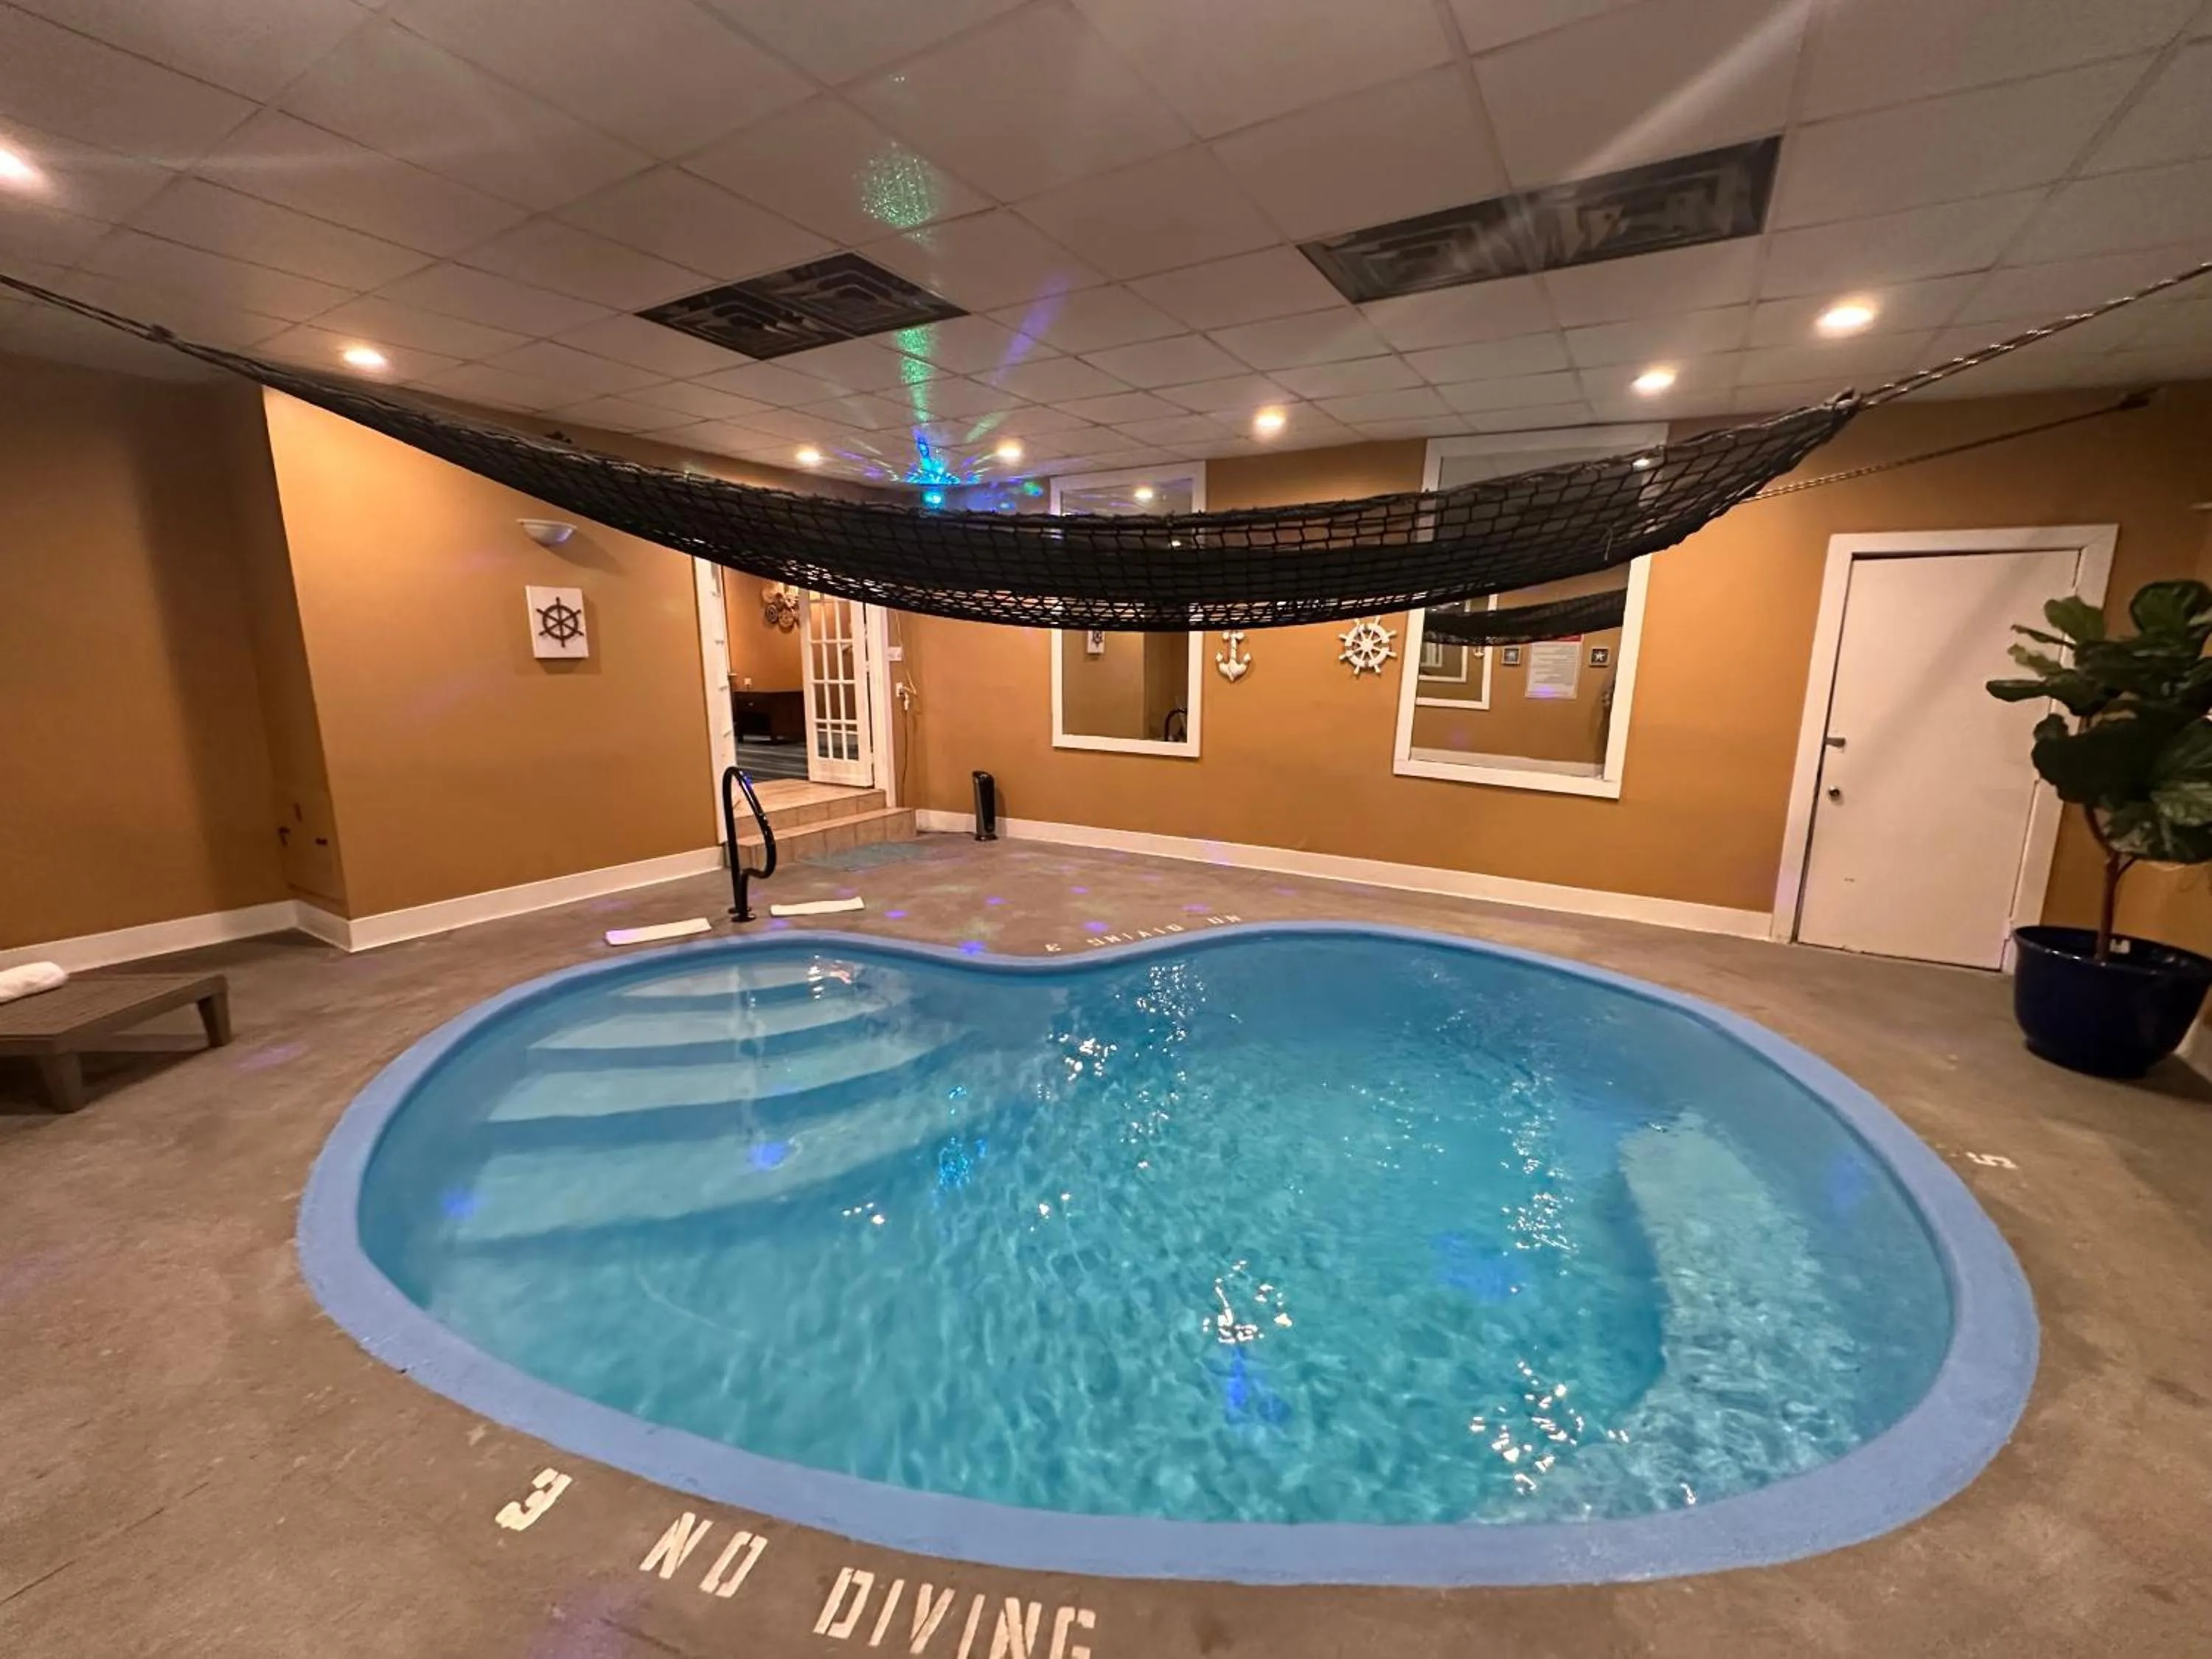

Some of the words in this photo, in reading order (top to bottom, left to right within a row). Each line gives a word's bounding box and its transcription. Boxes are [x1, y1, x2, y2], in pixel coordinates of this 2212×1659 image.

[495, 1467, 573, 1531] 3
[639, 1512, 768, 1598] NO
[813, 1567, 1096, 1659] DIVING
